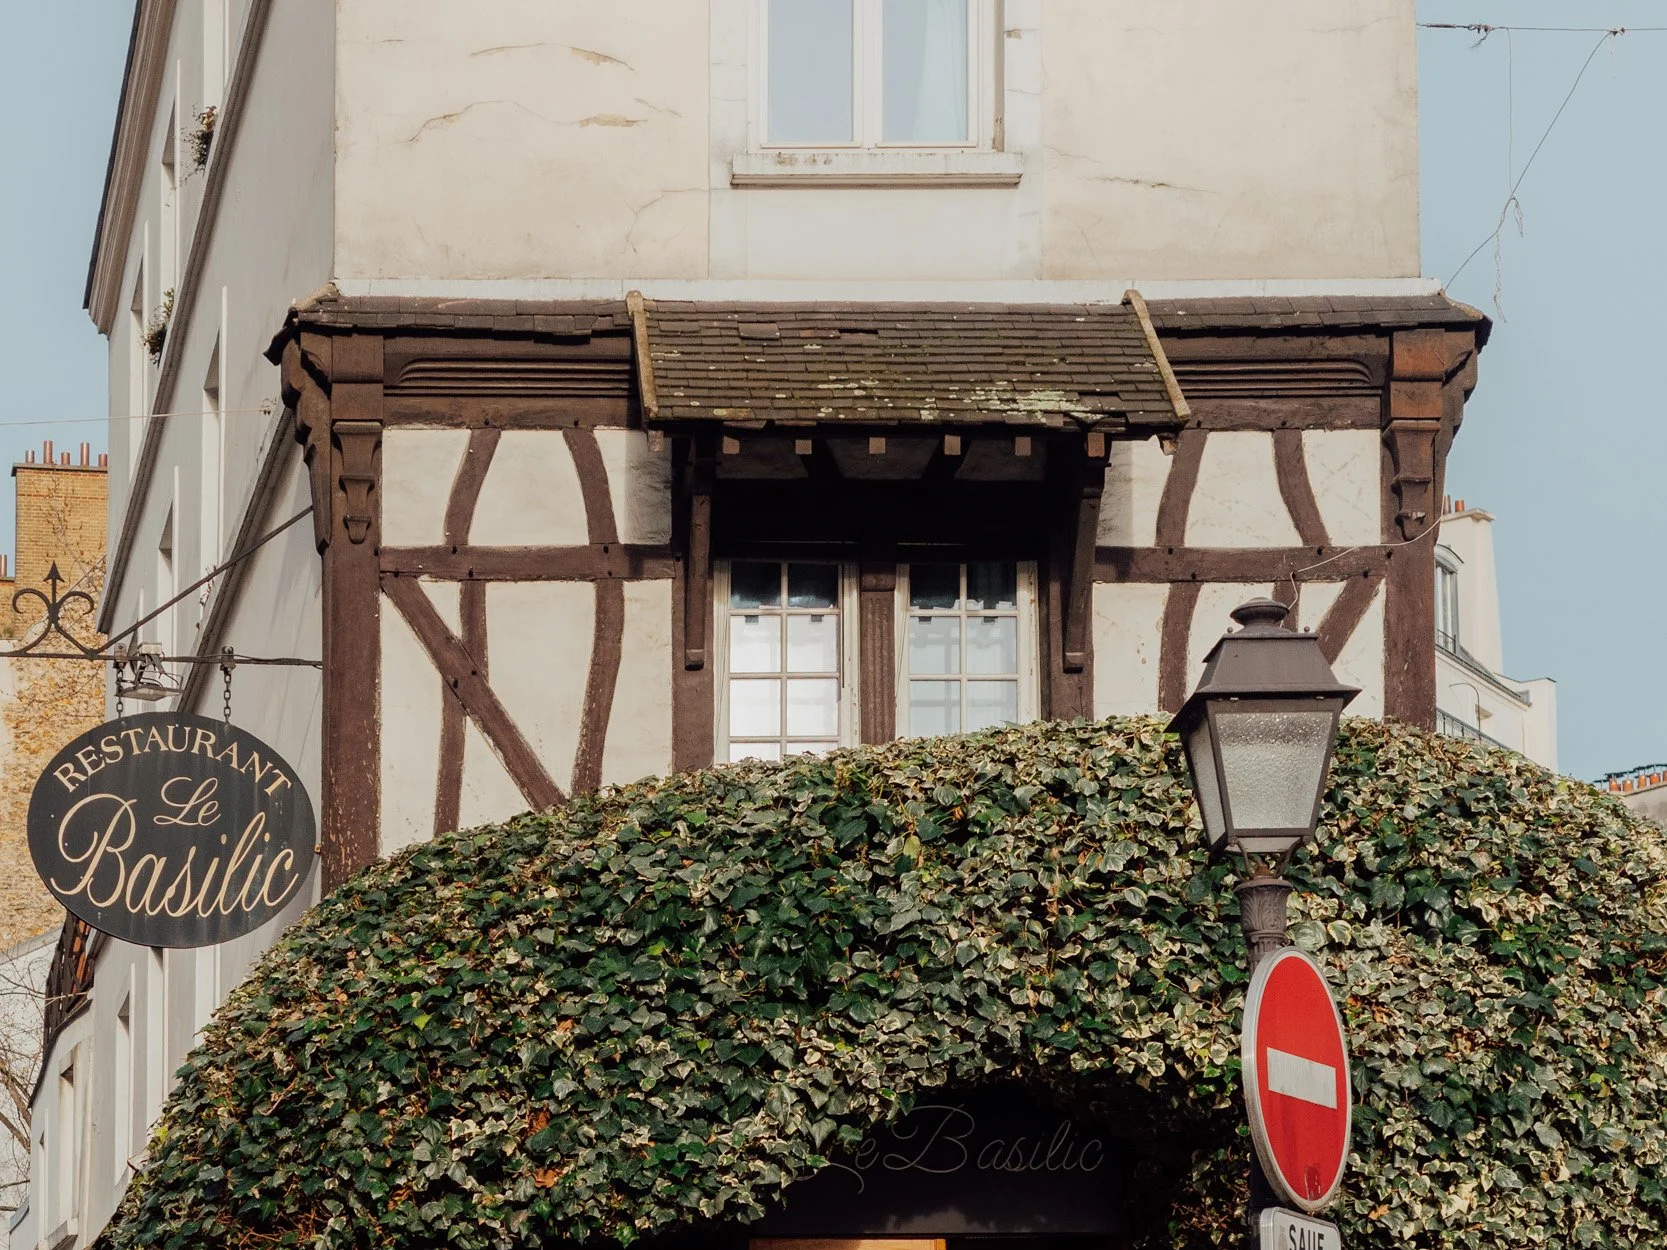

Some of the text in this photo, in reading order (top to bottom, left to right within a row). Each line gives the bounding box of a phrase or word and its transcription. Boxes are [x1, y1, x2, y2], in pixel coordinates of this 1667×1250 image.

[53, 725, 292, 796] RESTAURANT
[153, 776, 221, 826] Le
[50, 792, 299, 917] Basilic
[882, 1103, 1104, 1173] Basilic
